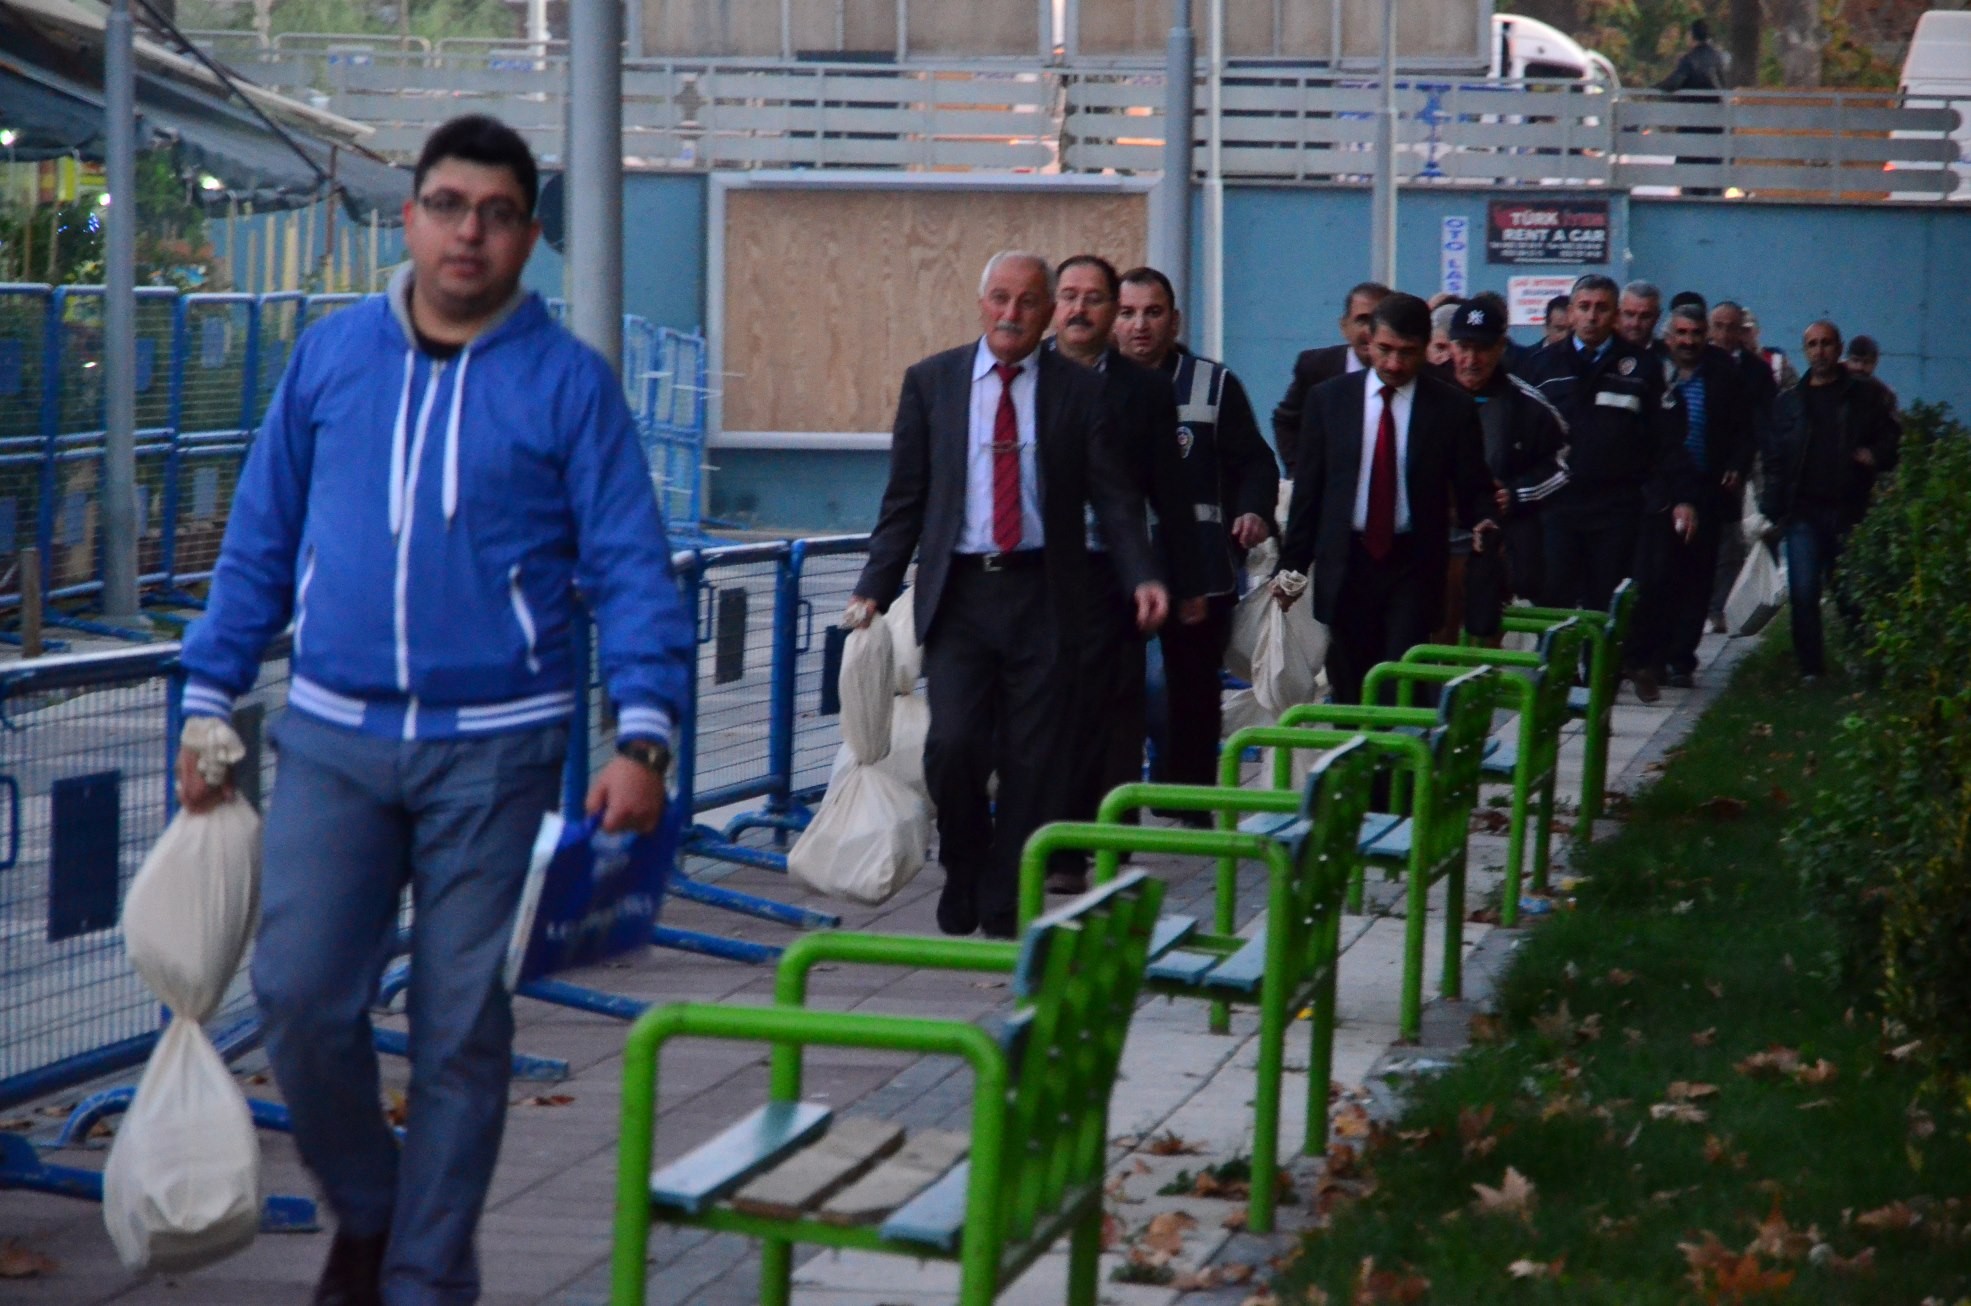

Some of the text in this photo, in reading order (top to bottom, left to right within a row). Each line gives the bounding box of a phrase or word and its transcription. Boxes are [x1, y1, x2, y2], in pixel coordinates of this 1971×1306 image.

[1510, 208, 1559, 227] TÜRK
[1445, 218, 1465, 251] OTO
[1501, 228, 1606, 242] RENT A CAR
